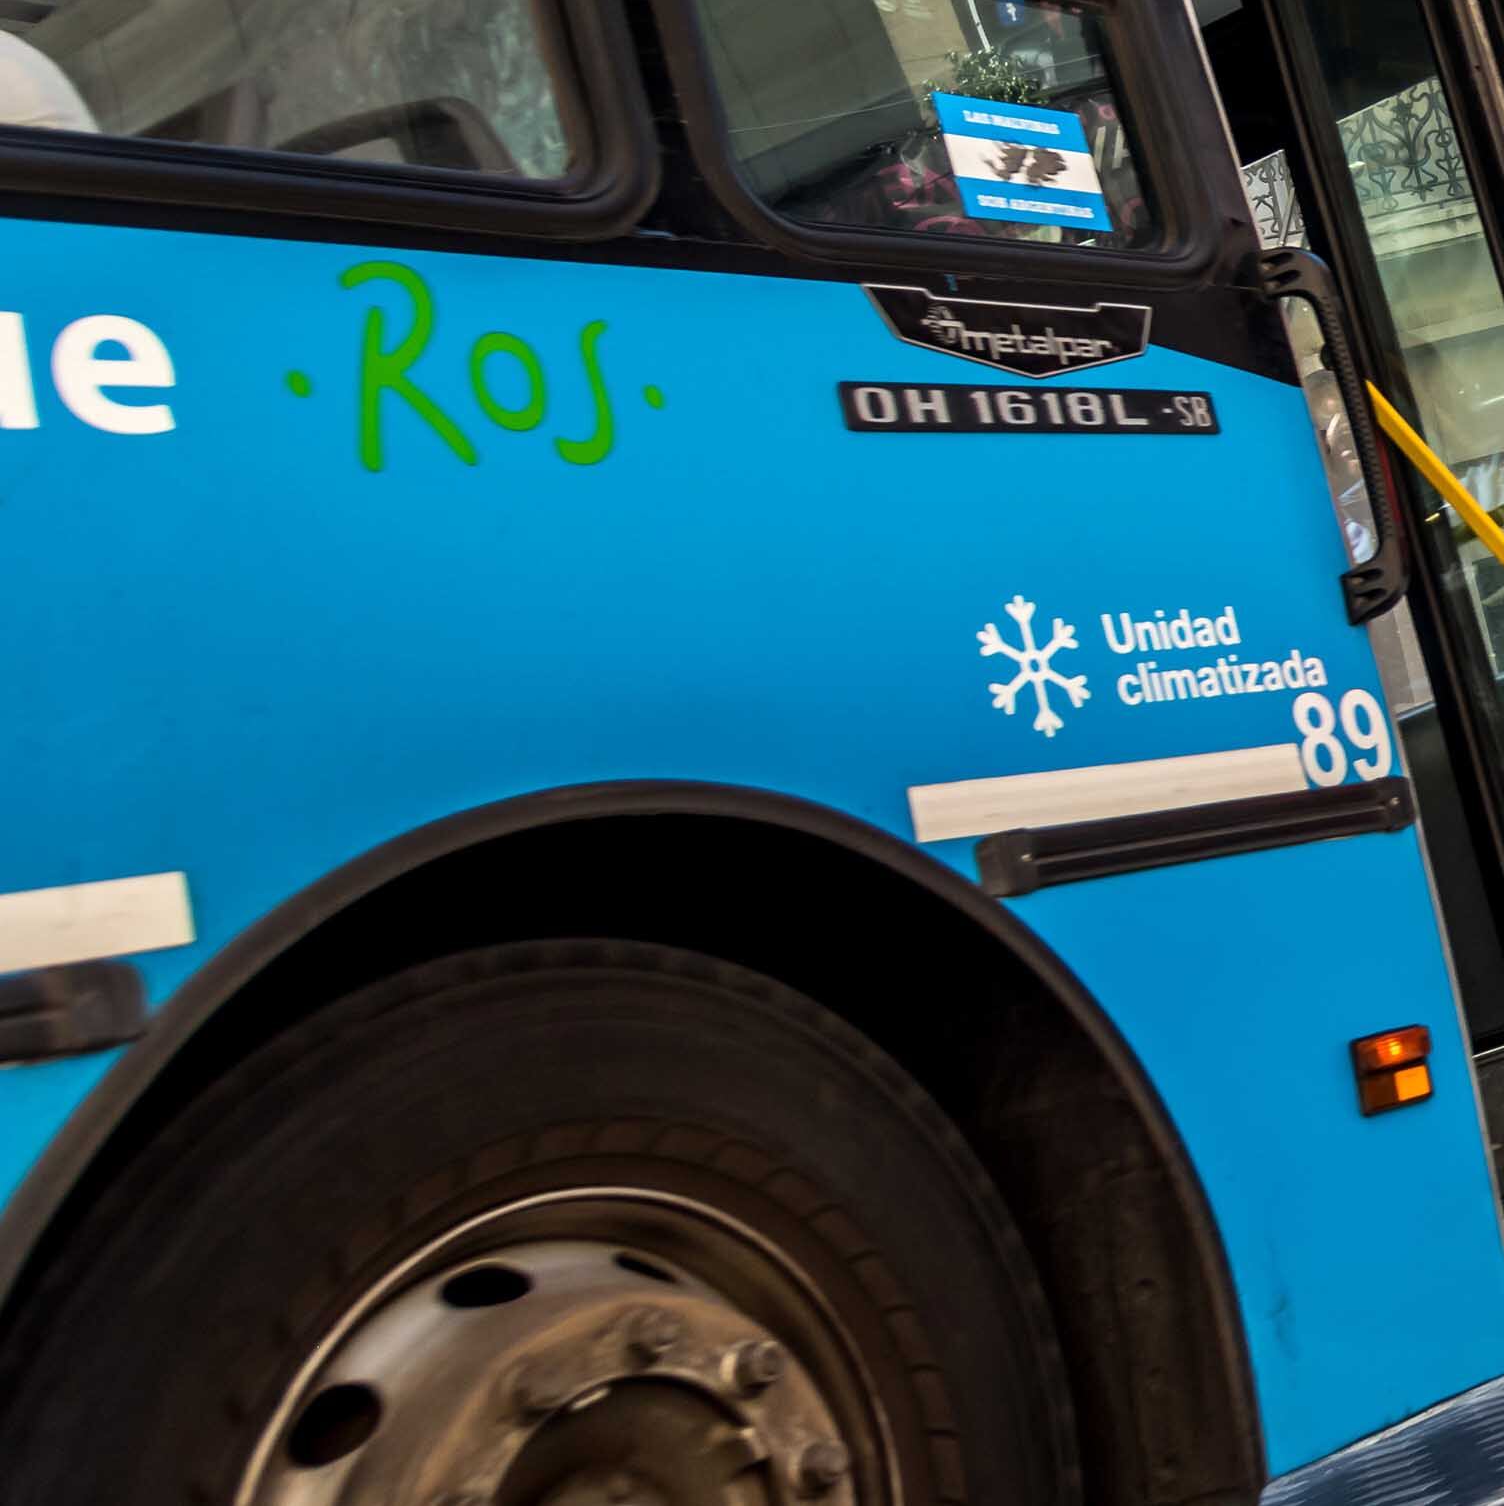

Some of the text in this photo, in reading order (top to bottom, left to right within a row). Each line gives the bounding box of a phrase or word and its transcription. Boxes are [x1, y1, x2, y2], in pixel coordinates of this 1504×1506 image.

[852, 386, 951, 425] OH
[1099, 605, 1240, 656] Unidad
[1116, 649, 1328, 707] climatizada
[1292, 688, 1394, 789] 89
